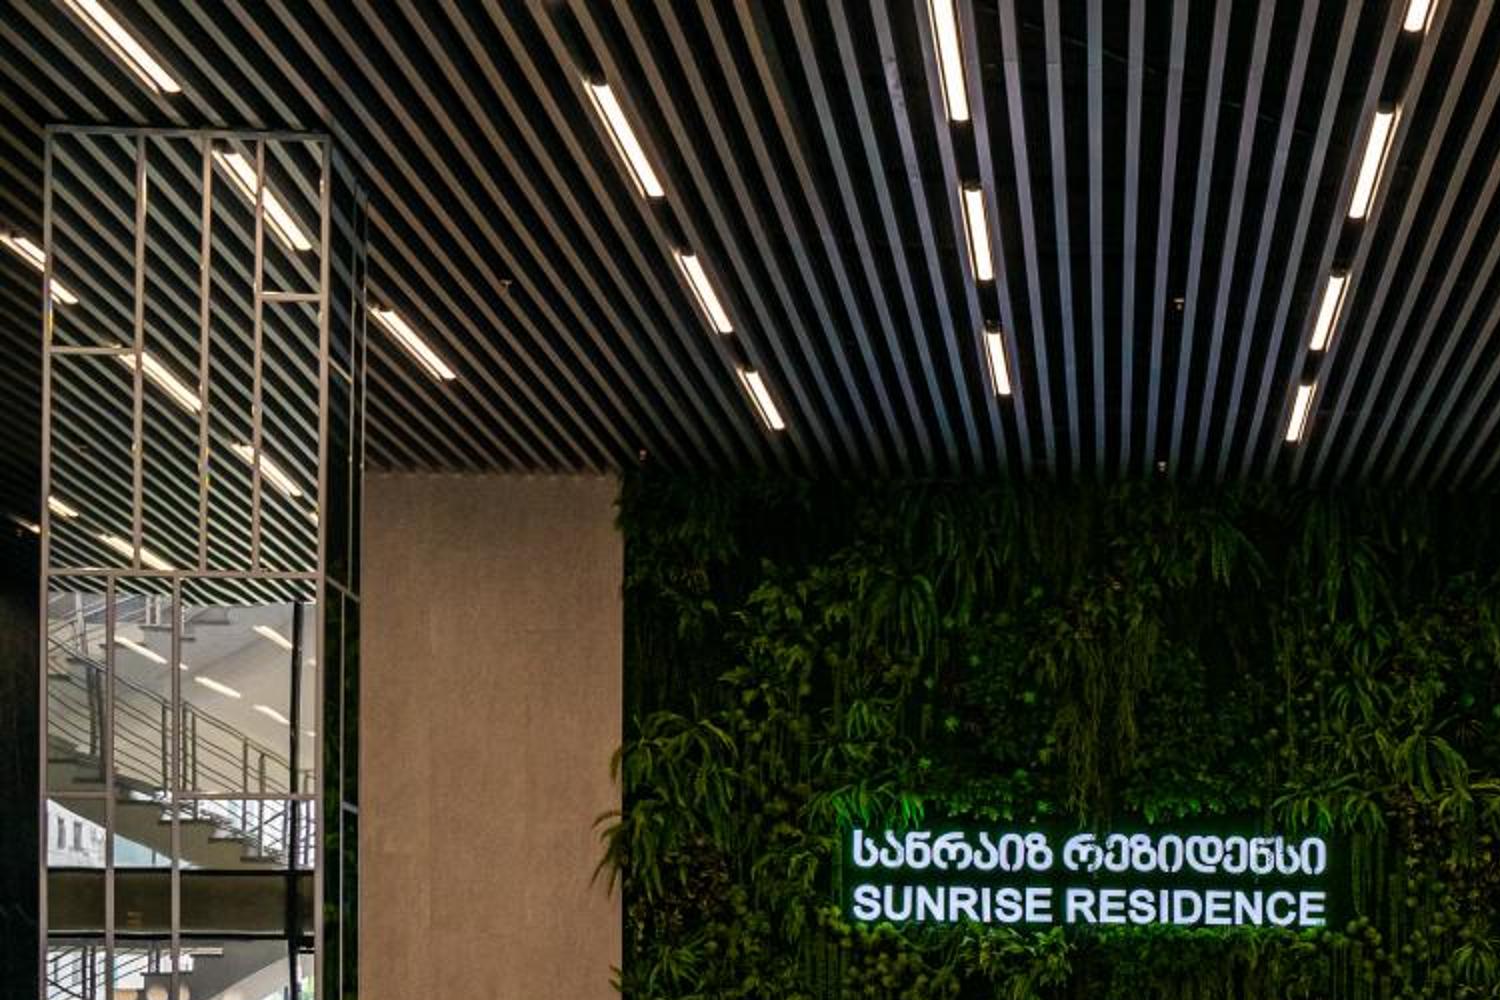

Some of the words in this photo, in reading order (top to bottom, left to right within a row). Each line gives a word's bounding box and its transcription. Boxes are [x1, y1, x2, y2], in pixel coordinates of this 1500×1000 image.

[853, 829, 1054, 871] სანრაიზ
[853, 885, 1053, 923] SUNRISE
[1066, 888, 1326, 926] RESIDENCE
